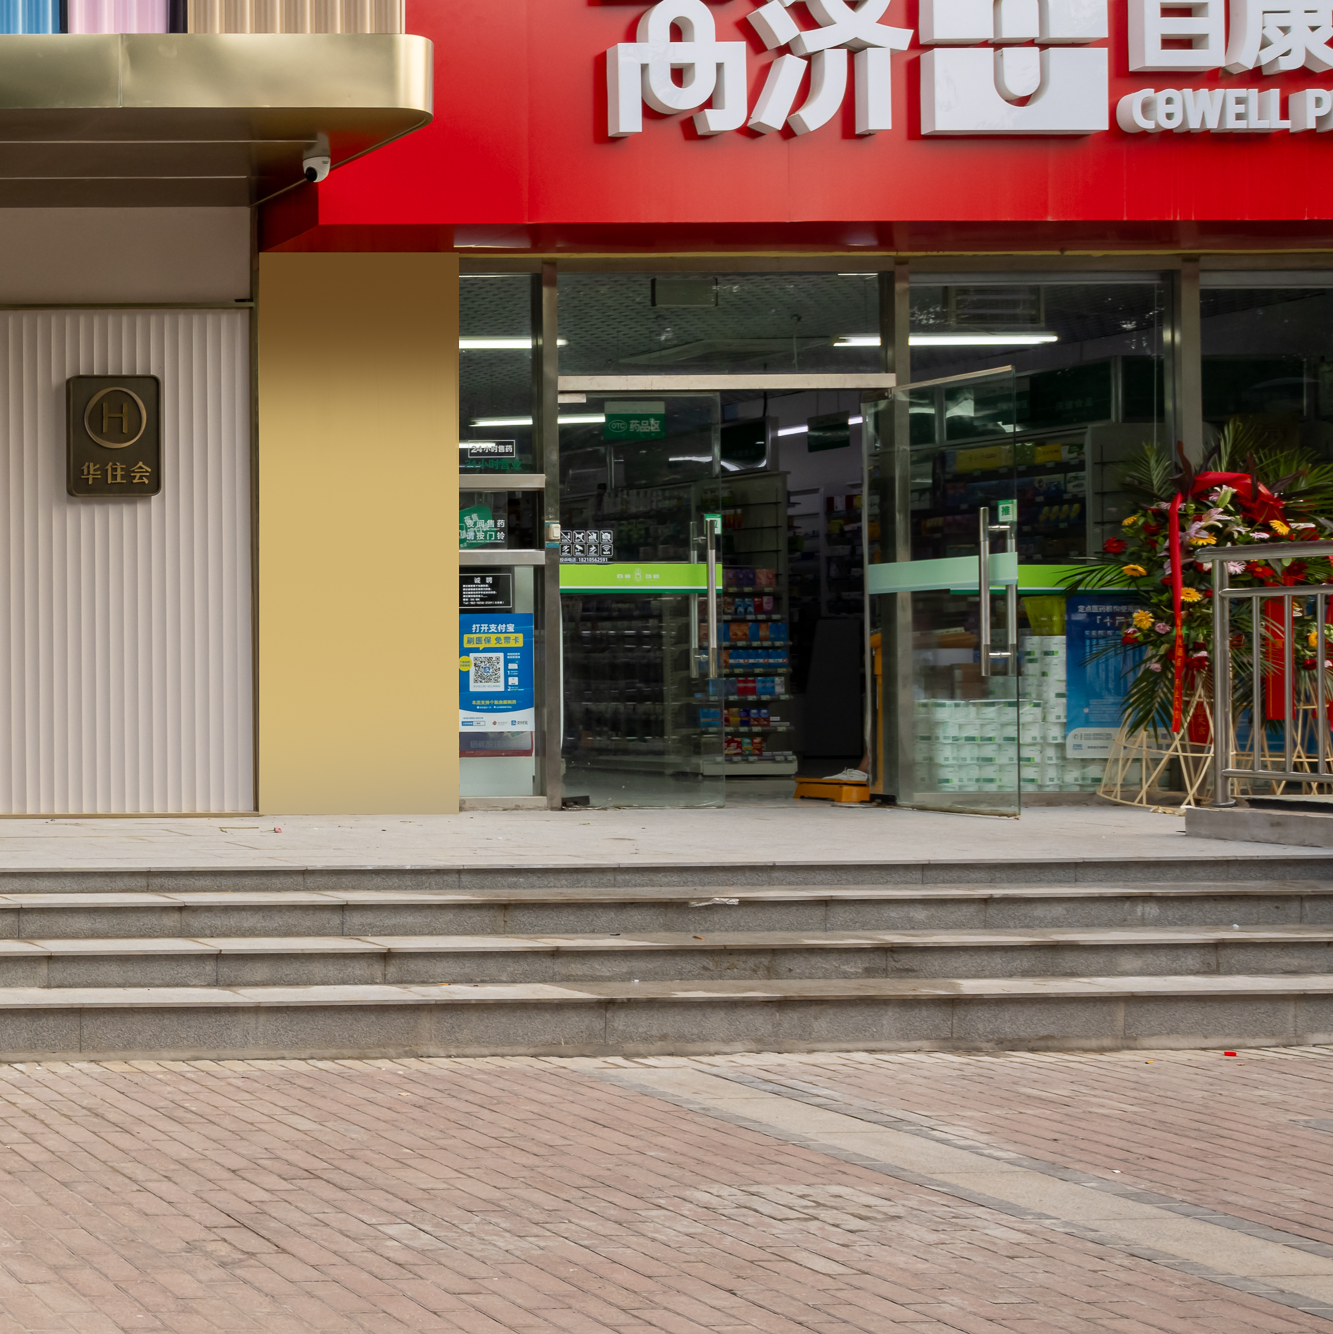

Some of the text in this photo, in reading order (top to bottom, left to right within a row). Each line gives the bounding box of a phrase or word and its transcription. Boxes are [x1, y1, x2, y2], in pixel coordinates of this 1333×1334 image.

[1117, 88, 1333, 134] COWELL P
[629, 418, 661, 432] 药品区
[80, 461, 152, 485] 华住会
[471, 623, 515, 633] 打开支付宝
